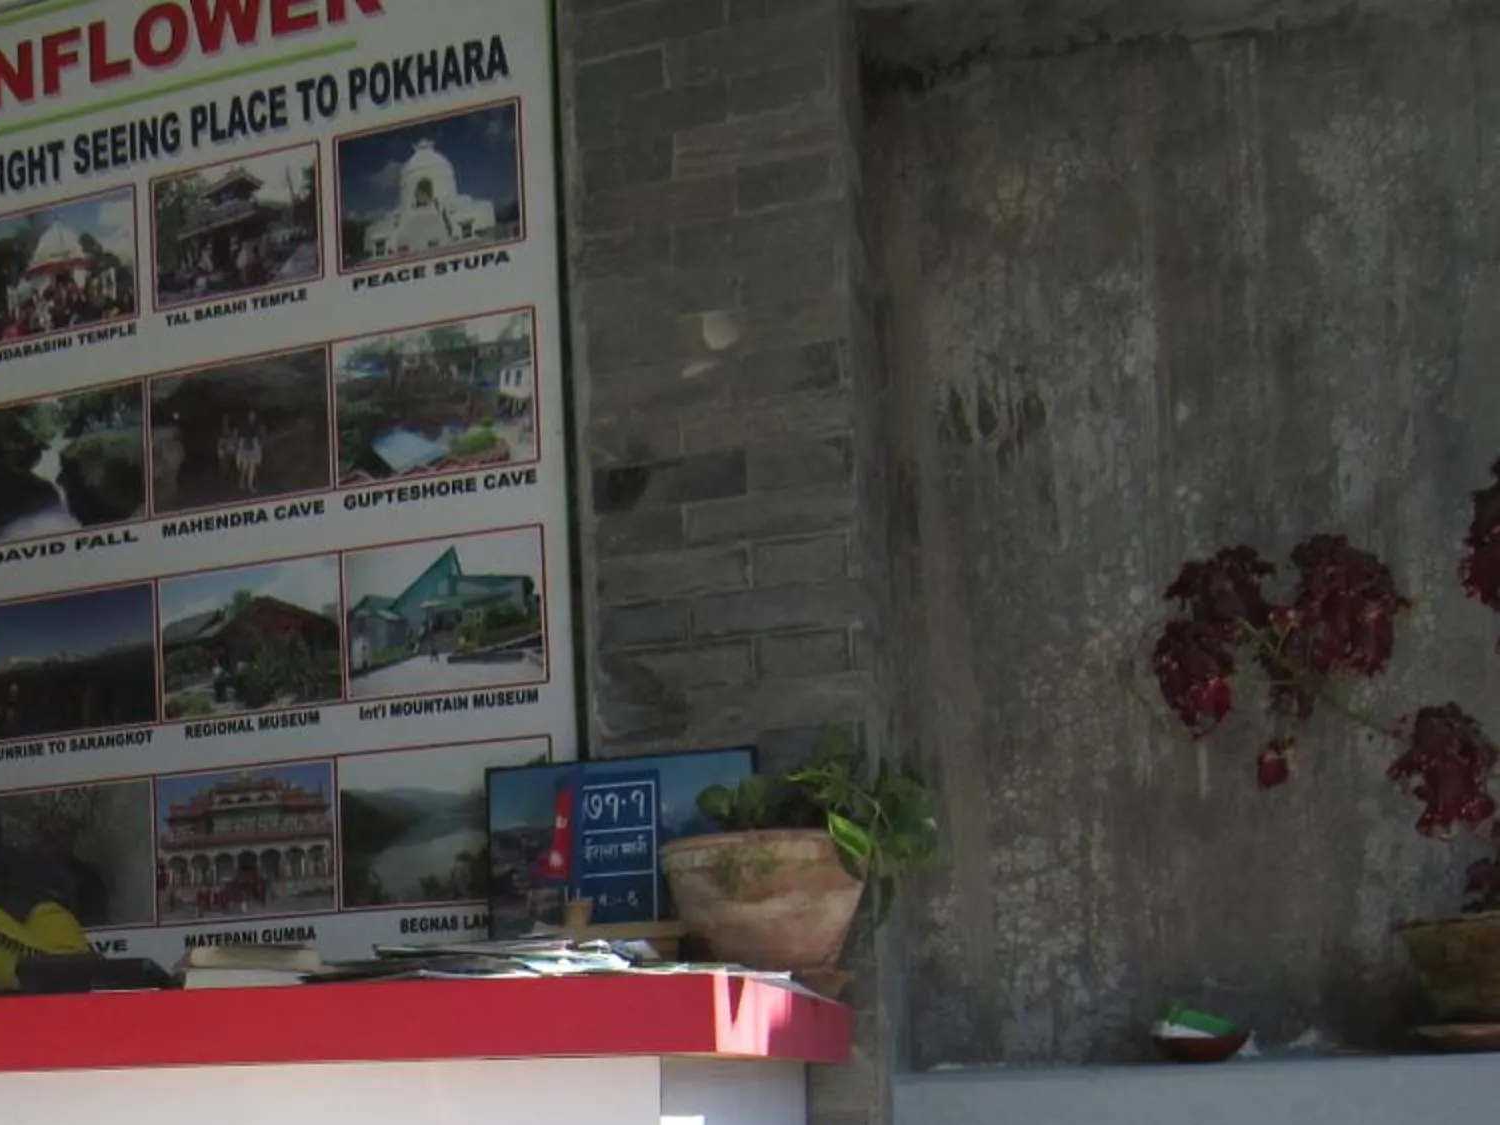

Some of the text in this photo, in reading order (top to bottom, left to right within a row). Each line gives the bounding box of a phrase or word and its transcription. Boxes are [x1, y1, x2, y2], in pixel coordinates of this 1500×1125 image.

[73, 112, 182, 175] SEEING
[190, 85, 288, 147] PLACE
[297, 76, 338, 121] TO
[348, 35, 509, 111] POKHARA
[352, 250, 511, 291] PEACE STUPA
[165, 288, 308, 327] TAL BARAHI TEMPLE
[78, 324, 137, 347] TEMPLE
[342, 468, 538, 512] GUPTESHORE CAVE
[161, 499, 325, 539] MAHENDRA CAVE
[73, 529, 140, 553] FALL
[390, 696, 470, 719] MOUNTAIN
[474, 687, 540, 709] MUSEUM
[184, 709, 322, 740] REGIONAL MUSEUM
[47, 739, 68, 755] TO
[69, 730, 154, 752] SARANGKOT
[184, 925, 318, 949] MATEPANI GUMBA
[400, 915, 459, 934] BEGNAS
